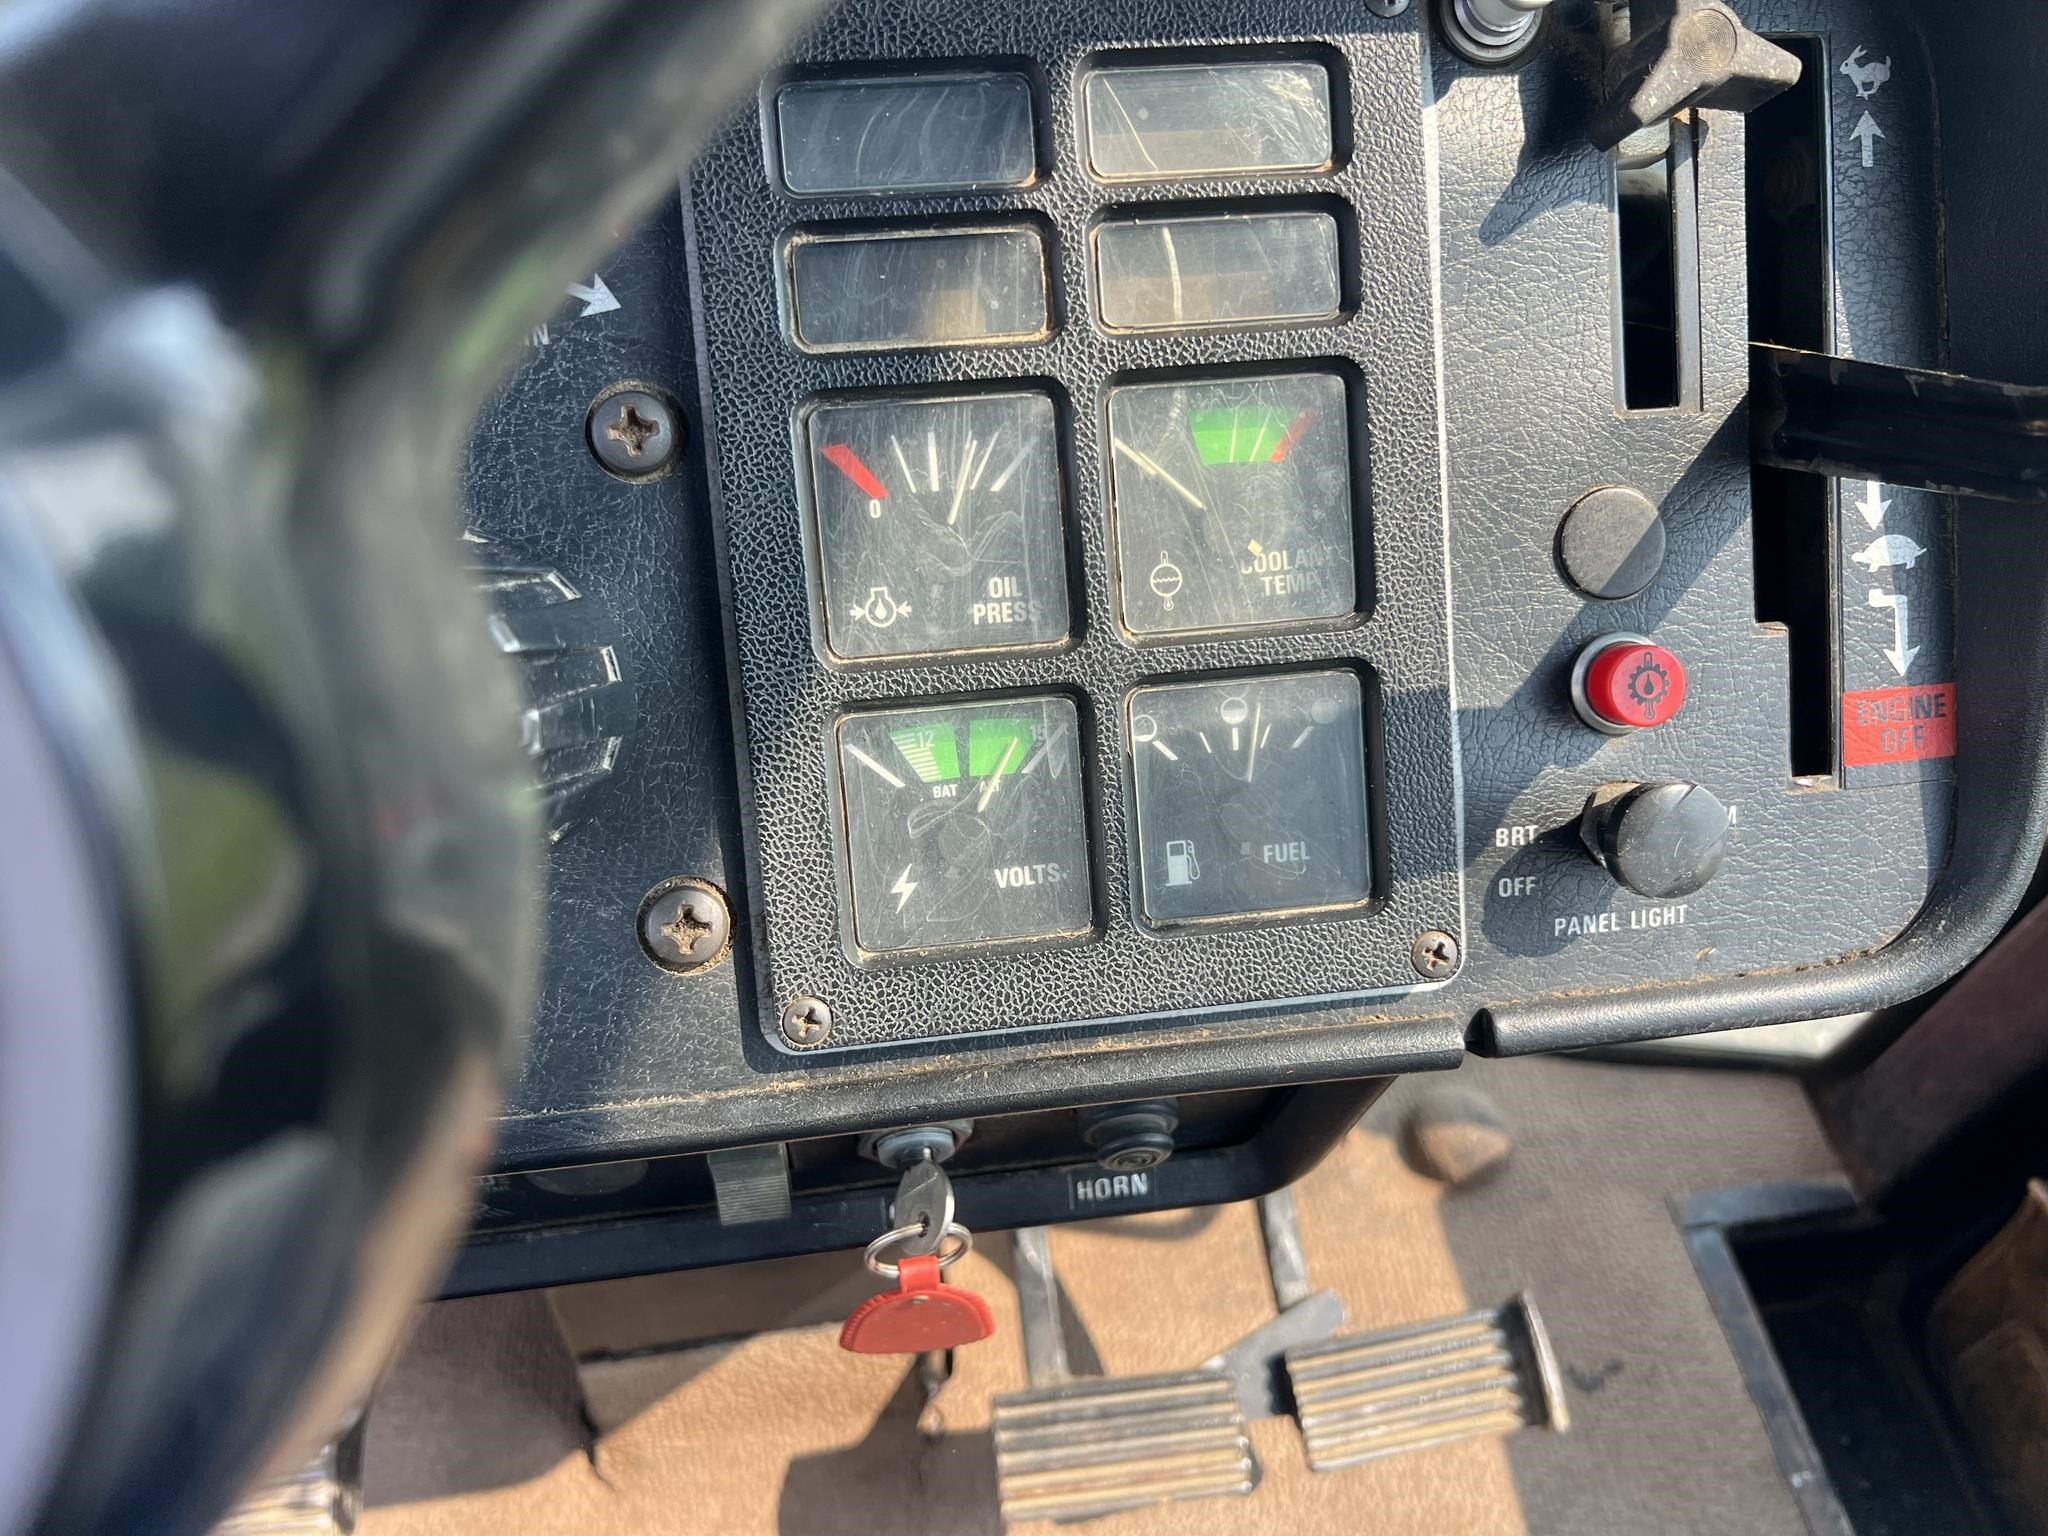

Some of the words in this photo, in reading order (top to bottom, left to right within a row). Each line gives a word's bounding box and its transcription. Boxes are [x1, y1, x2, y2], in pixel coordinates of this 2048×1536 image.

[988, 576, 1023, 599] OIL
[1260, 571, 1319, 597] TEMP
[972, 600, 1042, 625] PRESS
[1856, 693, 1947, 727] ENGINE
[1880, 725, 1926, 753] OFF
[932, 783, 958, 799] BAT
[1263, 840, 1312, 864] FUEL
[994, 862, 1061, 889] VOLTS
[1498, 876, 1537, 898] OFF
[1554, 912, 1621, 937] PANEL
[1630, 904, 1688, 930] LIGHT
[1076, 1172, 1149, 1202] HORN
